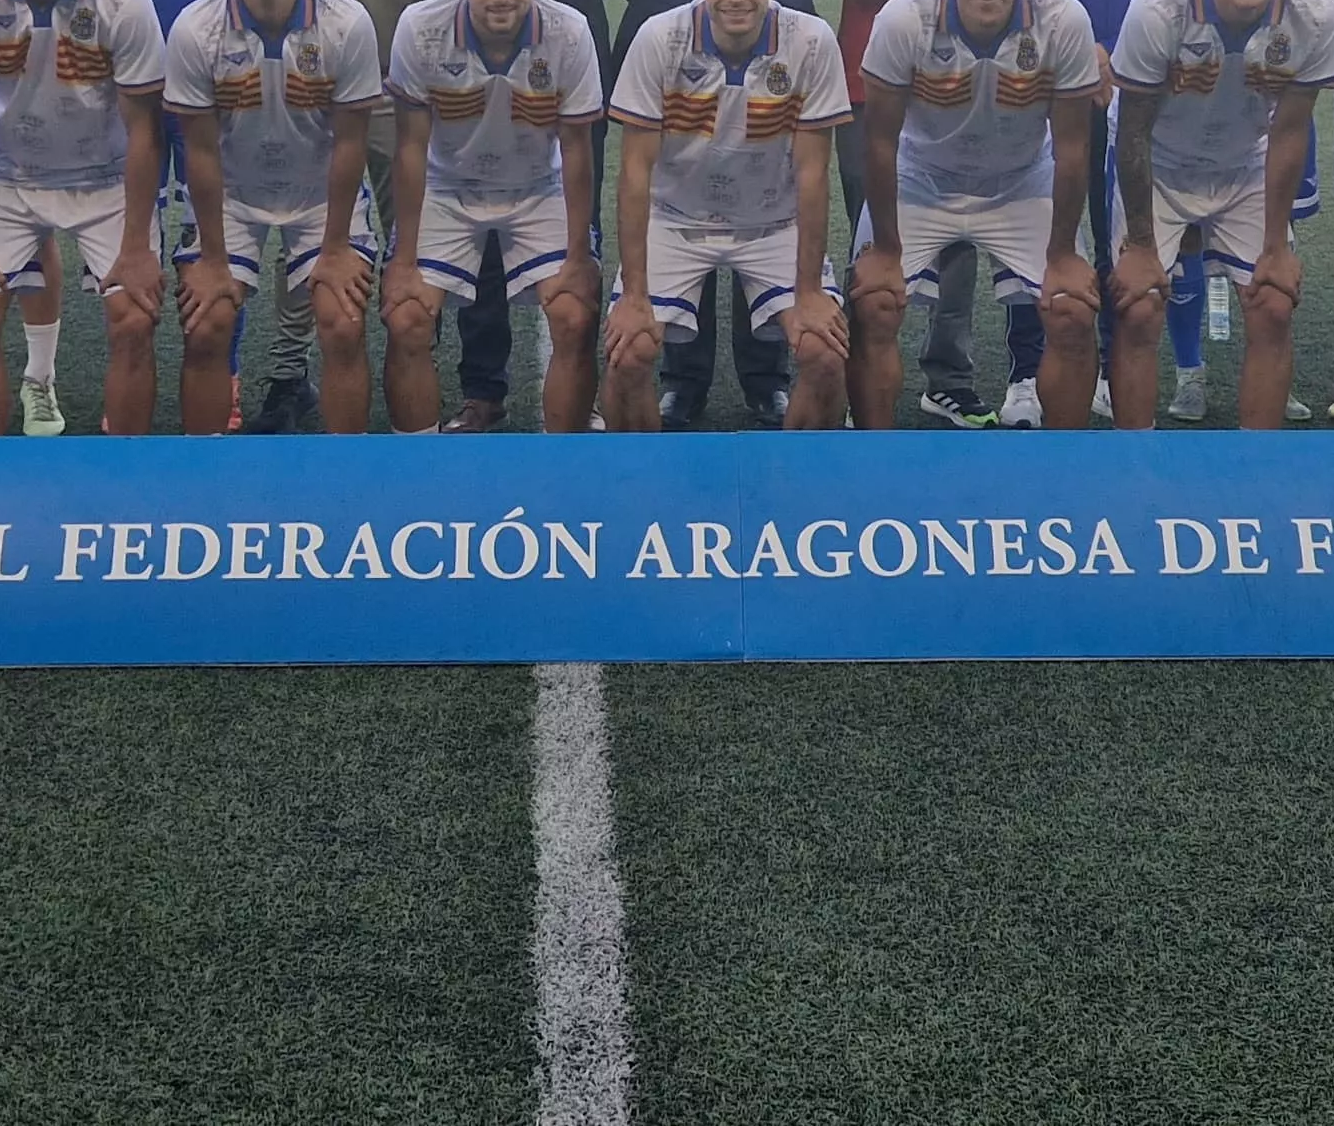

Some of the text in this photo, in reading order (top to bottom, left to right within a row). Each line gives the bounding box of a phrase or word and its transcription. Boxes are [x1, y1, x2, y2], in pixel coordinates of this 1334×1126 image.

[55, 507, 602, 580] FEDERACIÓN
[627, 519, 1134, 578] ARAGONESA
[1156, 519, 1268, 573] DE
